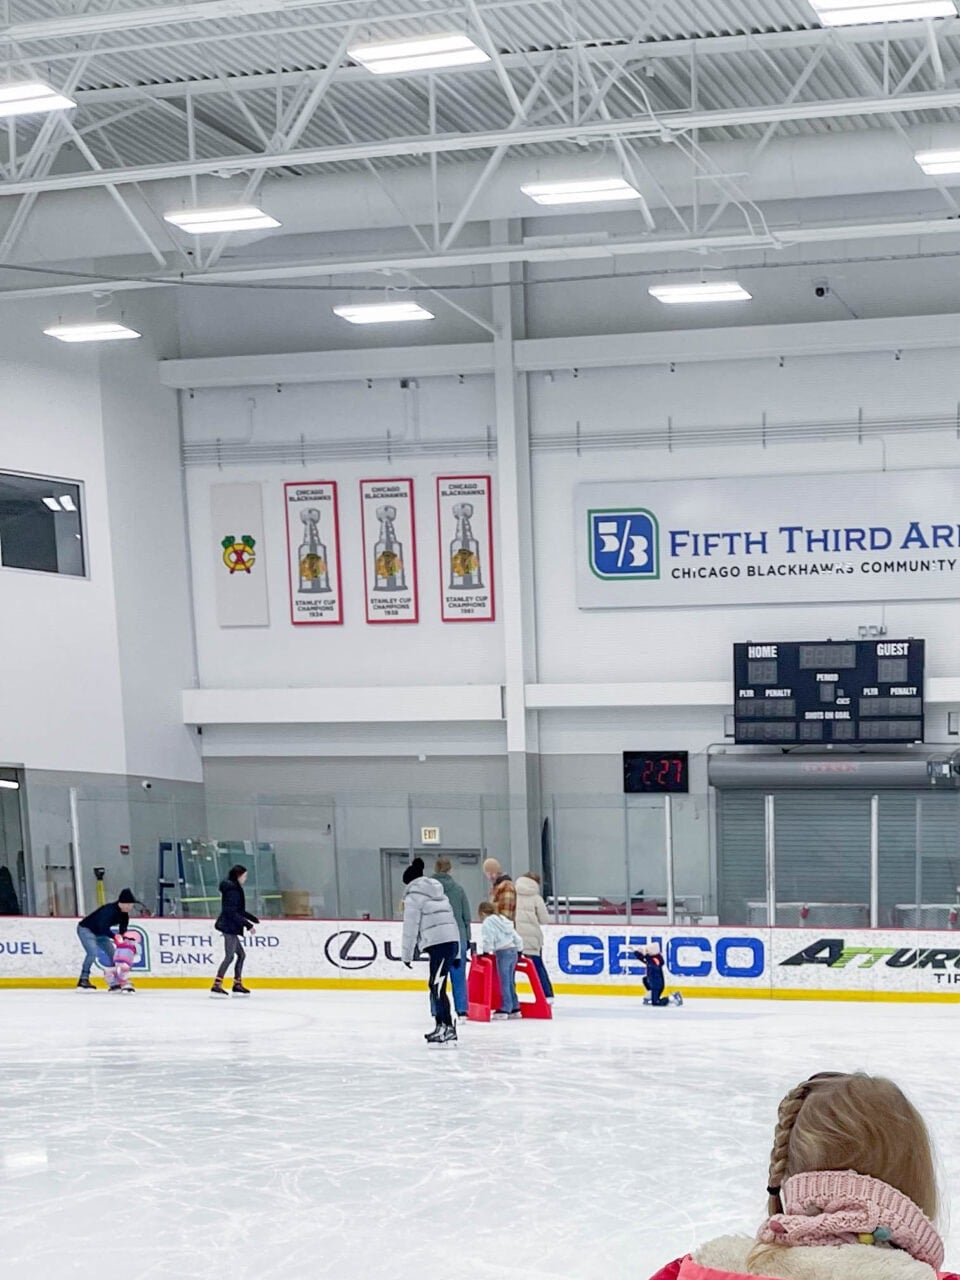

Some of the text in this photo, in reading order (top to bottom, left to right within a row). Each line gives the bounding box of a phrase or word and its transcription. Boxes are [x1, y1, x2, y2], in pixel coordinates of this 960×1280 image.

[441, 489, 485, 497] BLACKHAWKS
[669, 530, 768, 557] FIFTH
[779, 526, 892, 553] THIRD
[671, 566, 741, 579] CHICAGO
[861, 559, 957, 574] COMMUNTY
[748, 646, 778, 658] HOME
[876, 643, 909, 656] GUEST
[816, 673, 839, 681] PERIOD
[765, 689, 792, 697] PENALTY
[890, 687, 917, 696] PENALTY
[805, 711, 850, 719] SHOTS ON GOAL
[424, 829, 437, 839] EXIT
[159, 933, 279, 947] FIFTH HIRD
[160, 953, 214, 964] BANK
[558, 935, 765, 978] GECO
